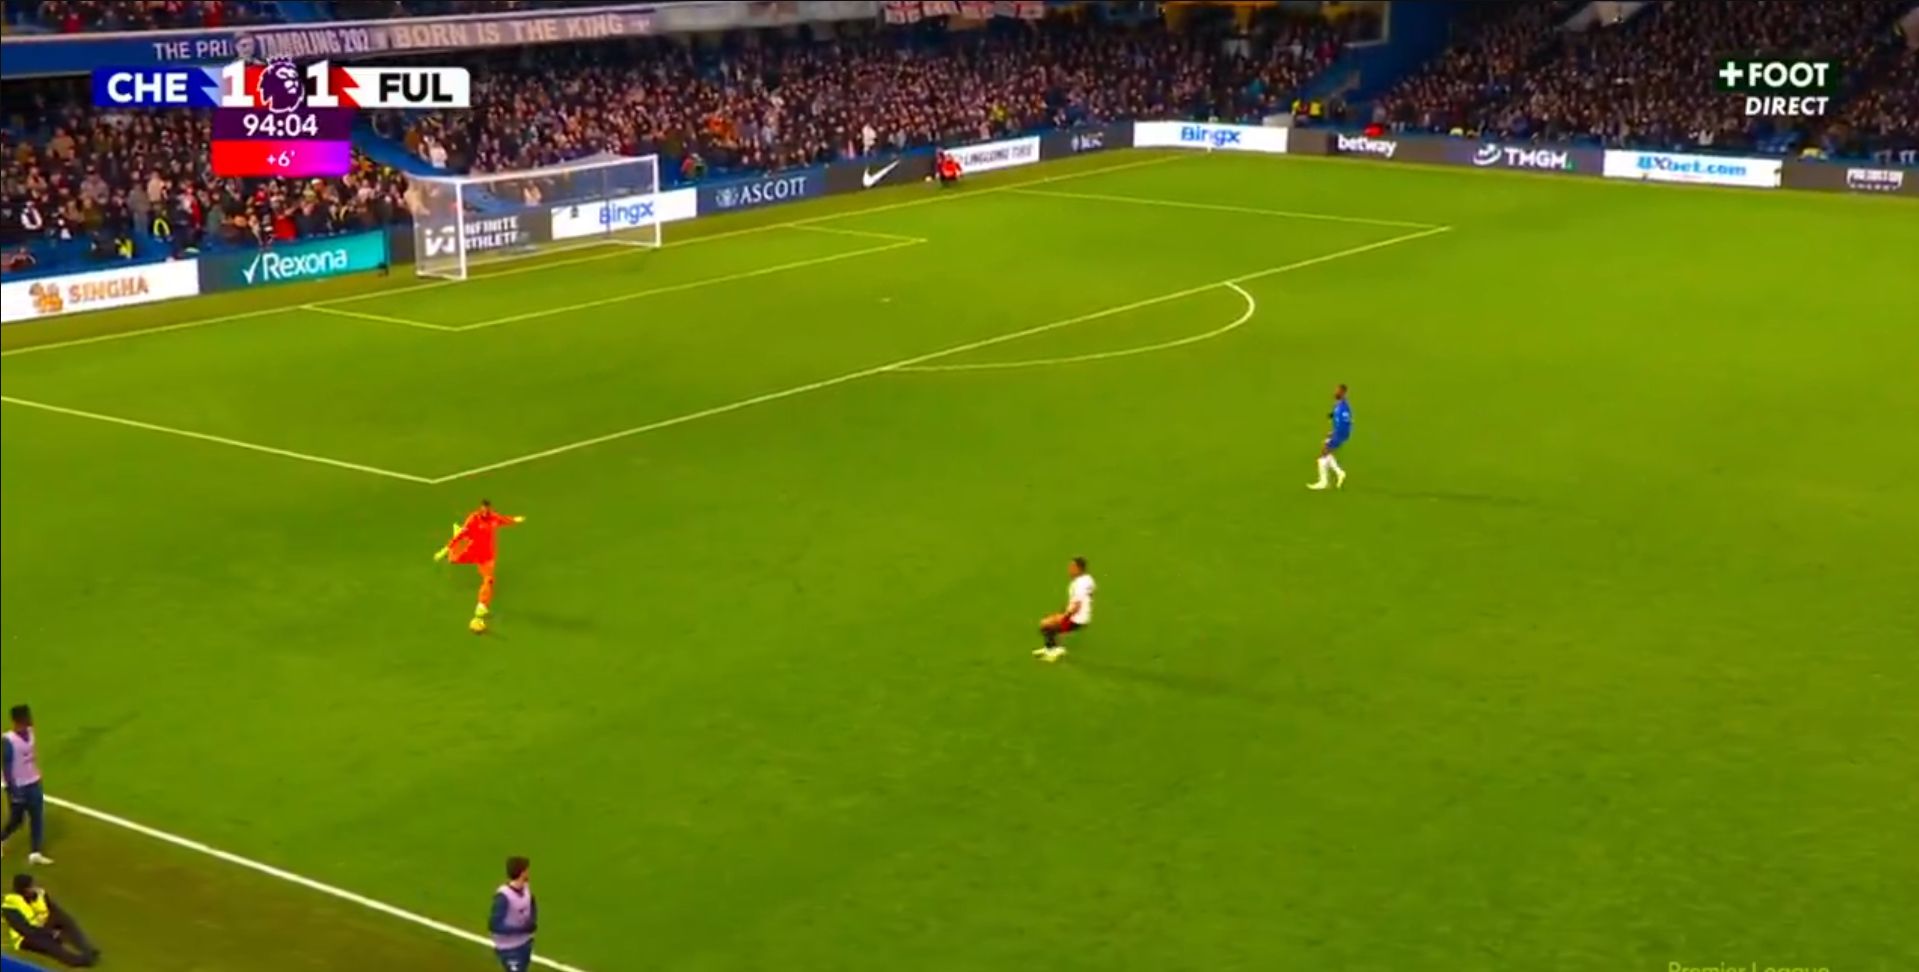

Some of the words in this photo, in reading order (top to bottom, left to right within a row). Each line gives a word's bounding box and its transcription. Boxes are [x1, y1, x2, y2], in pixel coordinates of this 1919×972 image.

[152, 42, 191, 61] THE
[195, 39, 230, 60] PRI
[255, 29, 340, 58] TAMBLING
[391, 23, 467, 49] BORN
[478, 21, 500, 44] IS
[512, 17, 559, 42] THE
[565, 14, 624, 39] KING
[1338, 134, 1397, 158] betway
[1503, 147, 1568, 169] TMGM
[740, 176, 809, 205] ASCOTT
[262, 248, 348, 281] Rexona
[68, 276, 149, 305] SINGHA
